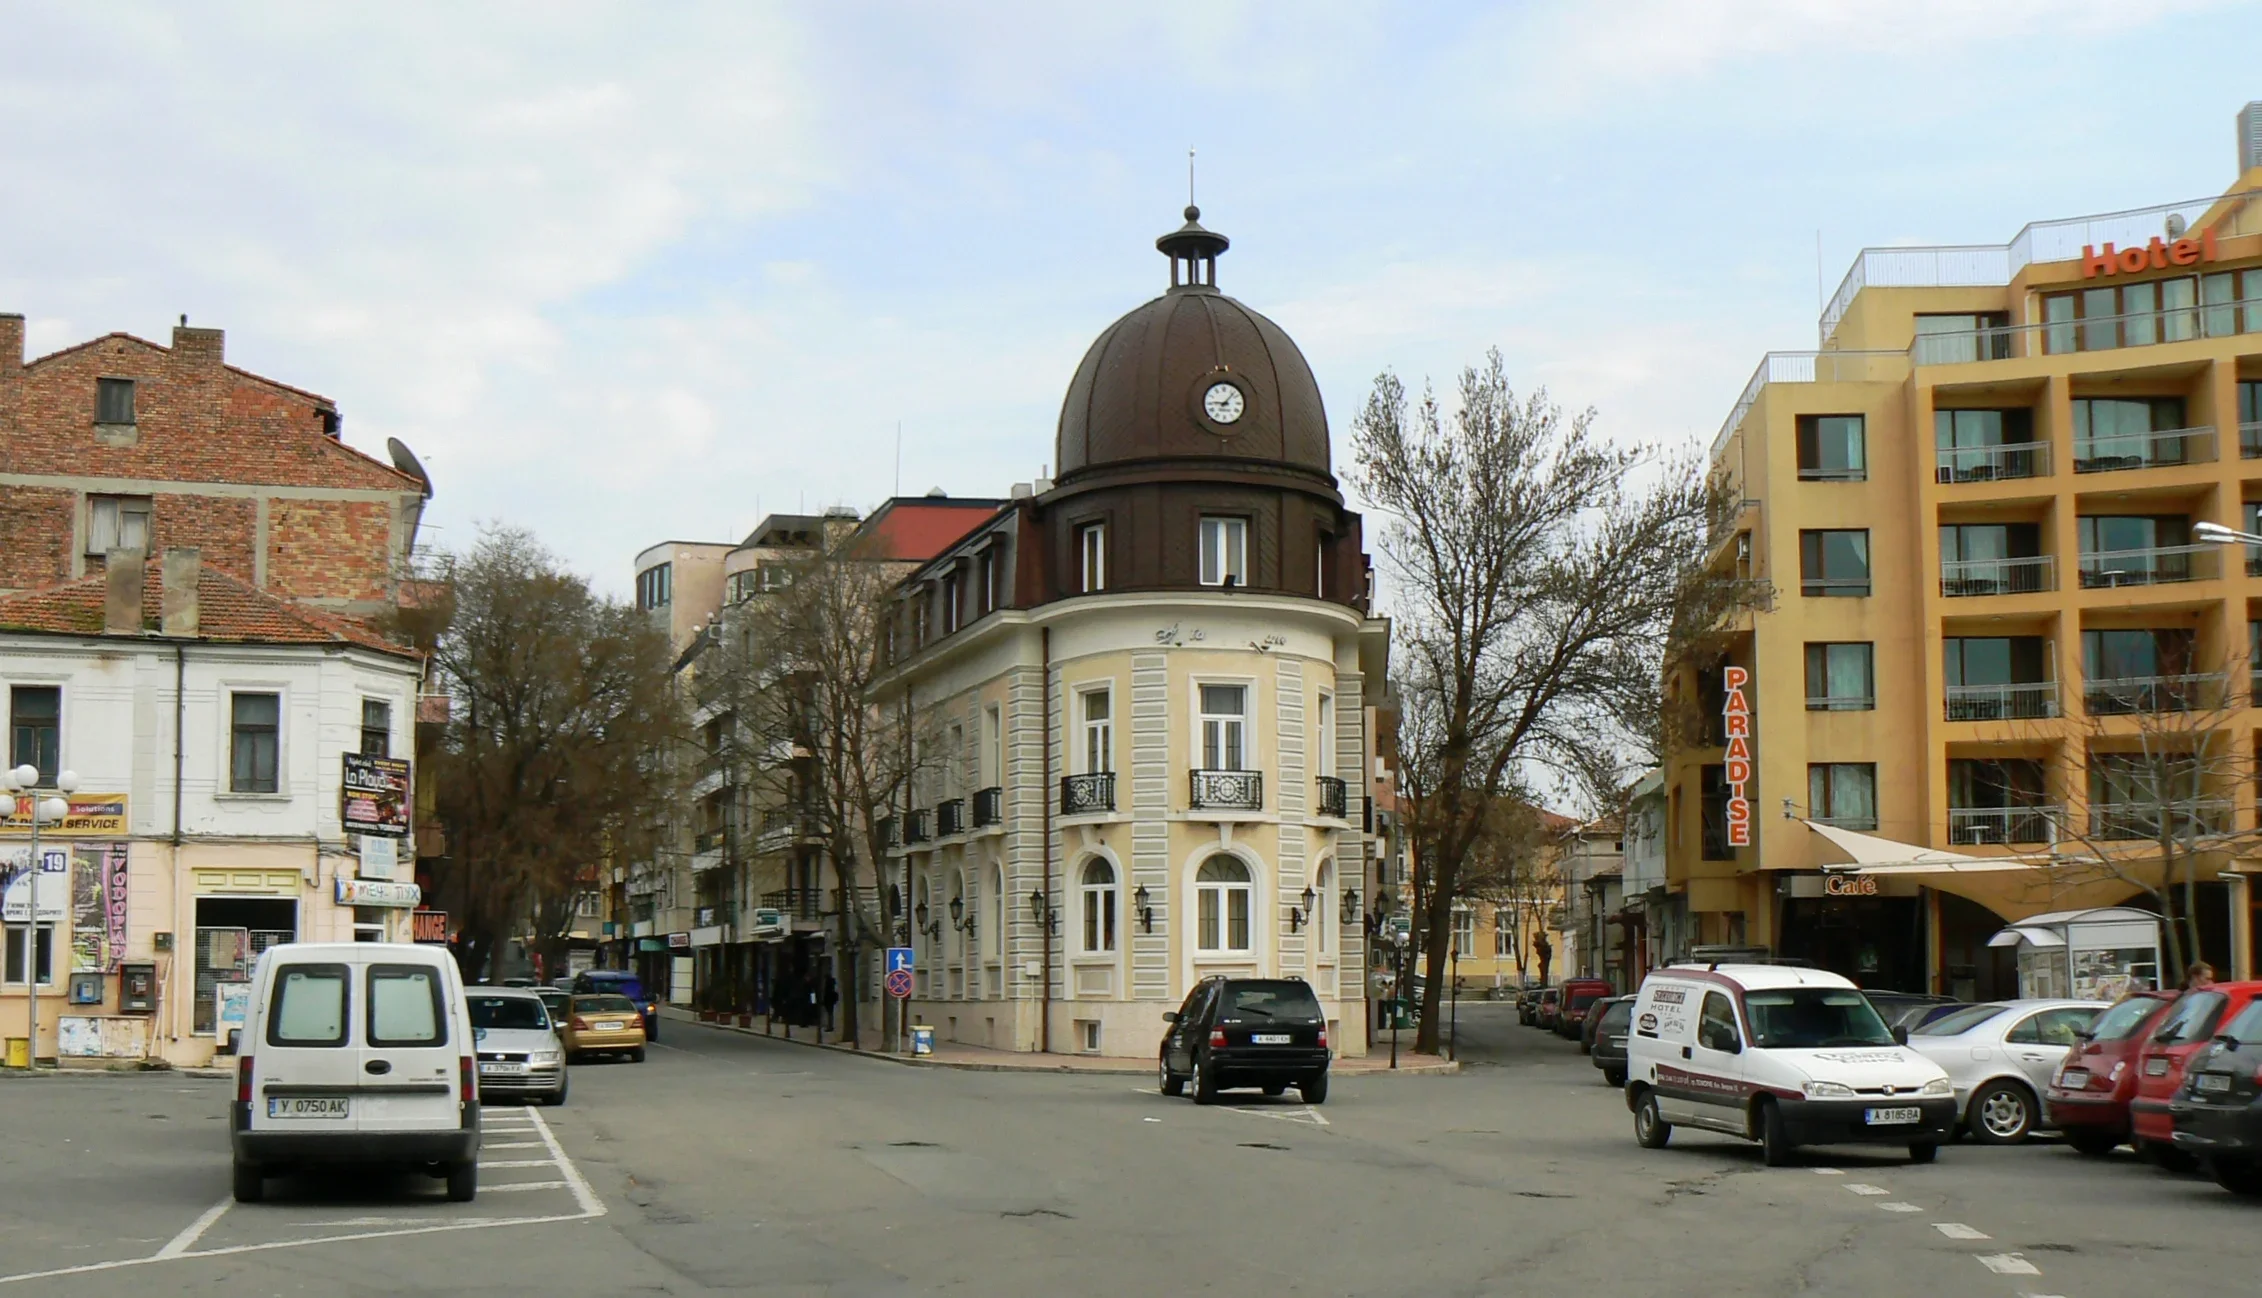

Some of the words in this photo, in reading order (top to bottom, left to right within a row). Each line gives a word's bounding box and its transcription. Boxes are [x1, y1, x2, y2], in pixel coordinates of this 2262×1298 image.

[2082, 227, 2218, 279] Hotel
[1722, 666, 1751, 847] PARADISE
[358, 768, 386, 789] Playa
[75, 805, 115, 813] Solutions
[66, 819, 119, 829] SERVICE
[45, 853, 64, 871] 19
[1824, 875, 1878, 896] Café
[413, 914, 446, 941] HANGE
[1650, 1004, 1682, 1013] HOTEL
[296, 1100, 327, 1112] 0750
[329, 1100, 346, 1112] AK
